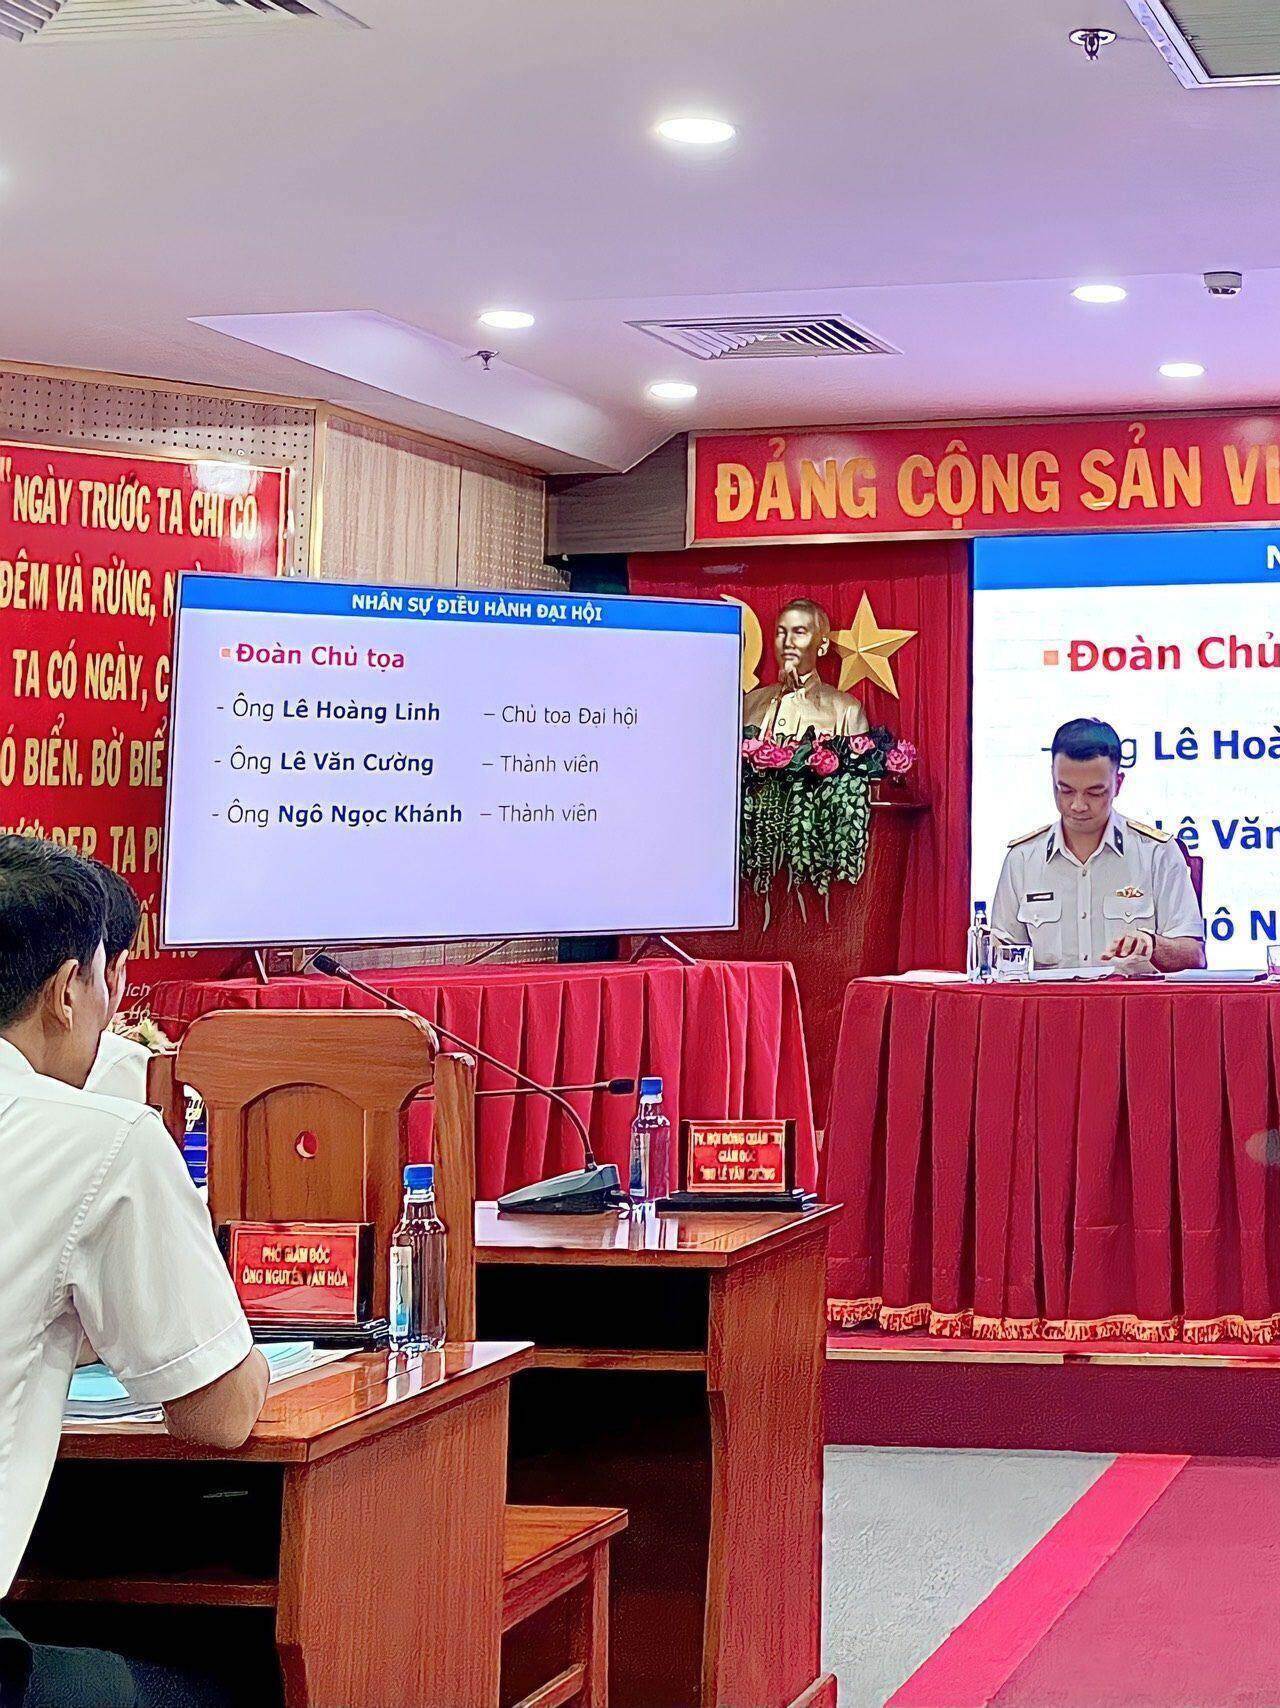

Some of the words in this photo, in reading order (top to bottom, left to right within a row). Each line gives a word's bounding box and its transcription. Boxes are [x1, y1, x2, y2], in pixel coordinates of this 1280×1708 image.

[714, 437, 877, 522] ĐẢNG
[897, 439, 1060, 529] CỘNG
[1079, 422, 1201, 511] SẢN
[78, 472, 151, 533] TRƯỚC
[157, 487, 183, 535] TA
[56, 552, 84, 613] VÀ
[91, 555, 156, 627] RỪNG,
[352, 592, 403, 611] NHÂN
[408, 596, 433, 616] SỰ
[436, 595, 479, 615] ĐIỀU
[484, 597, 532, 618] HÀNH
[536, 603, 567, 623] ĐẠI
[571, 601, 602, 624] HỘI
[236, 642, 301, 665] Đoàn
[311, 645, 357, 668] Chủ
[367, 648, 405, 672] tọa
[1067, 635, 1180, 672] Đoàn
[1198, 631, 1280, 670] Chủ
[13, 649, 40, 698] TA
[47, 639, 78, 699] CÓ
[84, 641, 148, 711] NGÀY,
[233, 692, 274, 721] Ông
[283, 698, 308, 718] Lê
[317, 700, 387, 723] Hoàng
[395, 702, 440, 721] Linh
[502, 704, 536, 723] Chủ
[579, 708, 606, 728] Đại
[613, 706, 638, 729] hội
[91, 726, 124, 787] BỜ
[129, 716, 167, 787] BIỂ
[1154, 726, 1199, 760] Lê
[230, 745, 271, 774] Ông
[281, 751, 306, 770] Lê
[314, 752, 354, 771] Văn
[363, 752, 434, 775] Cường
[500, 753, 556, 772] Thành
[564, 754, 598, 772] viên
[228, 798, 269, 827] Ông
[278, 804, 323, 827] Ngô
[332, 805, 387, 827] Ngọc
[394, 804, 462, 823] Khánh
[498, 803, 554, 822] Thành
[562, 803, 597, 822] viên
[110, 826, 136, 873] TA
